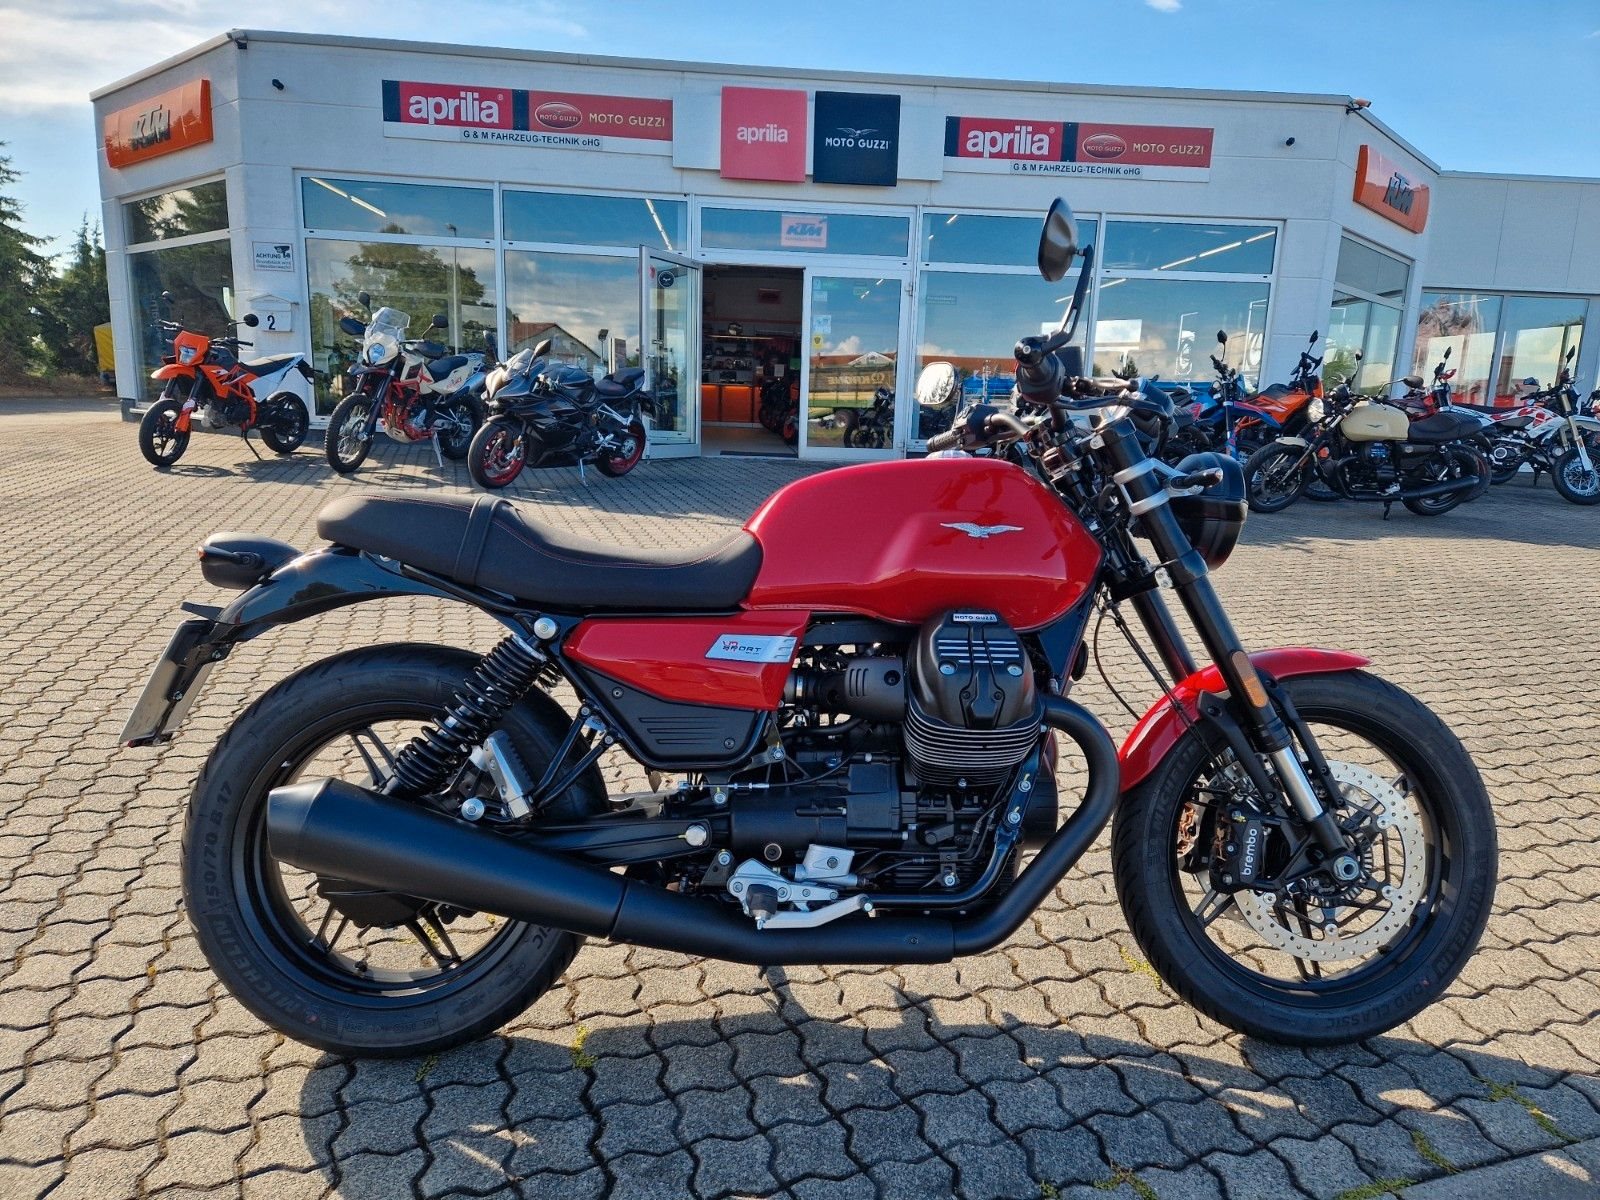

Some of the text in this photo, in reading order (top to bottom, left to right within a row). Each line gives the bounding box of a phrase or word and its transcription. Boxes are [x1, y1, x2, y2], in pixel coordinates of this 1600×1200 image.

[408, 91, 500, 125] aprilia
[589, 112, 665, 127] MOTO GUZZI
[130, 104, 171, 151] KTM
[463, 130, 600, 147] G & M FAHRZEUG-TECHNIK oHG
[736, 123, 789, 144] aprilia
[825, 137, 889, 150] MOTO GUZZI
[965, 125, 1050, 158] aprilia
[1132, 143, 1204, 155] MOTO GUZZI
[1013, 163, 1020, 171] G
[1021, 163, 1028, 171] &
[1038, 164, 1122, 175] FAHRZEUG-TECHNIK
[1123, 167, 1141, 176] oHG
[1383, 171, 1415, 216] KTM
[267, 314, 276, 331] 2
[216, 780, 234, 807] 17
[1241, 828, 1258, 876] brembo
[211, 918, 303, 1016] MICHELIN
